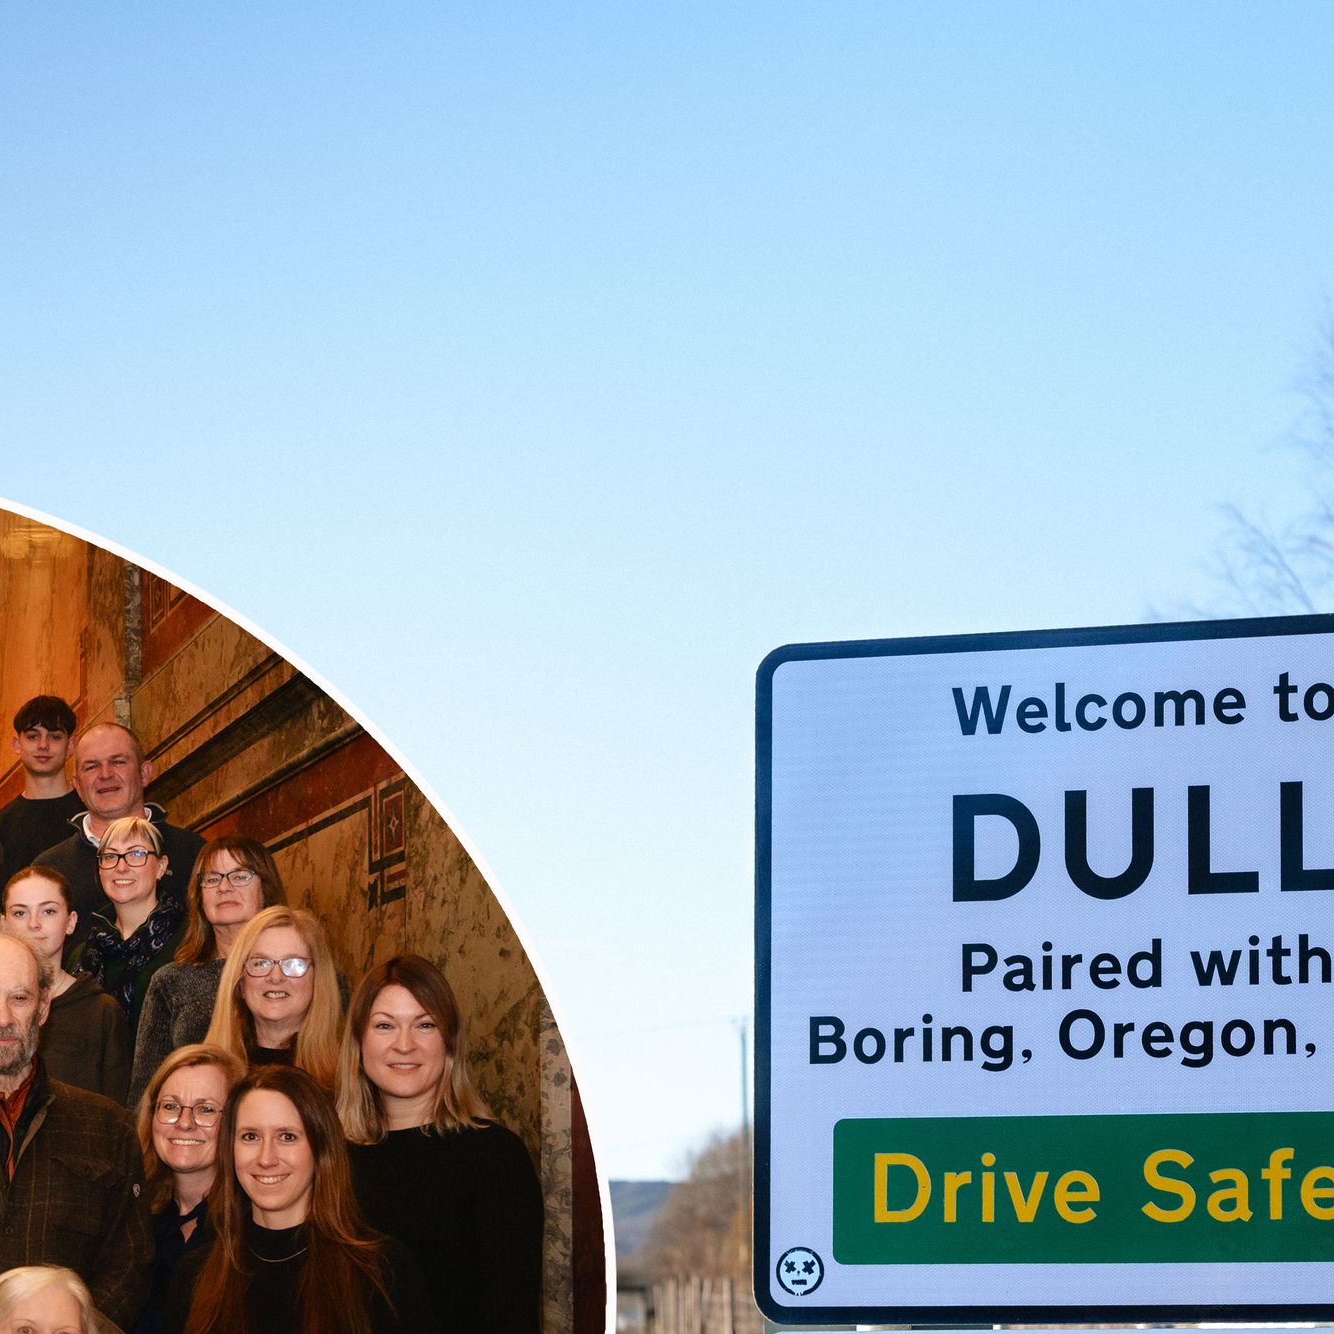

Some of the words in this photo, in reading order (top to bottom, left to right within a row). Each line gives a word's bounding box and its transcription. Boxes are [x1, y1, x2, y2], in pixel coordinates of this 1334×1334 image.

[951, 682, 1247, 736] Welcome
[961, 937, 1162, 993] Paired
[1189, 933, 1333, 987] with
[809, 1013, 1033, 1073] Boring,
[1058, 1008, 1317, 1069] Oregon,
[873, 1152, 1101, 1224] Drive
